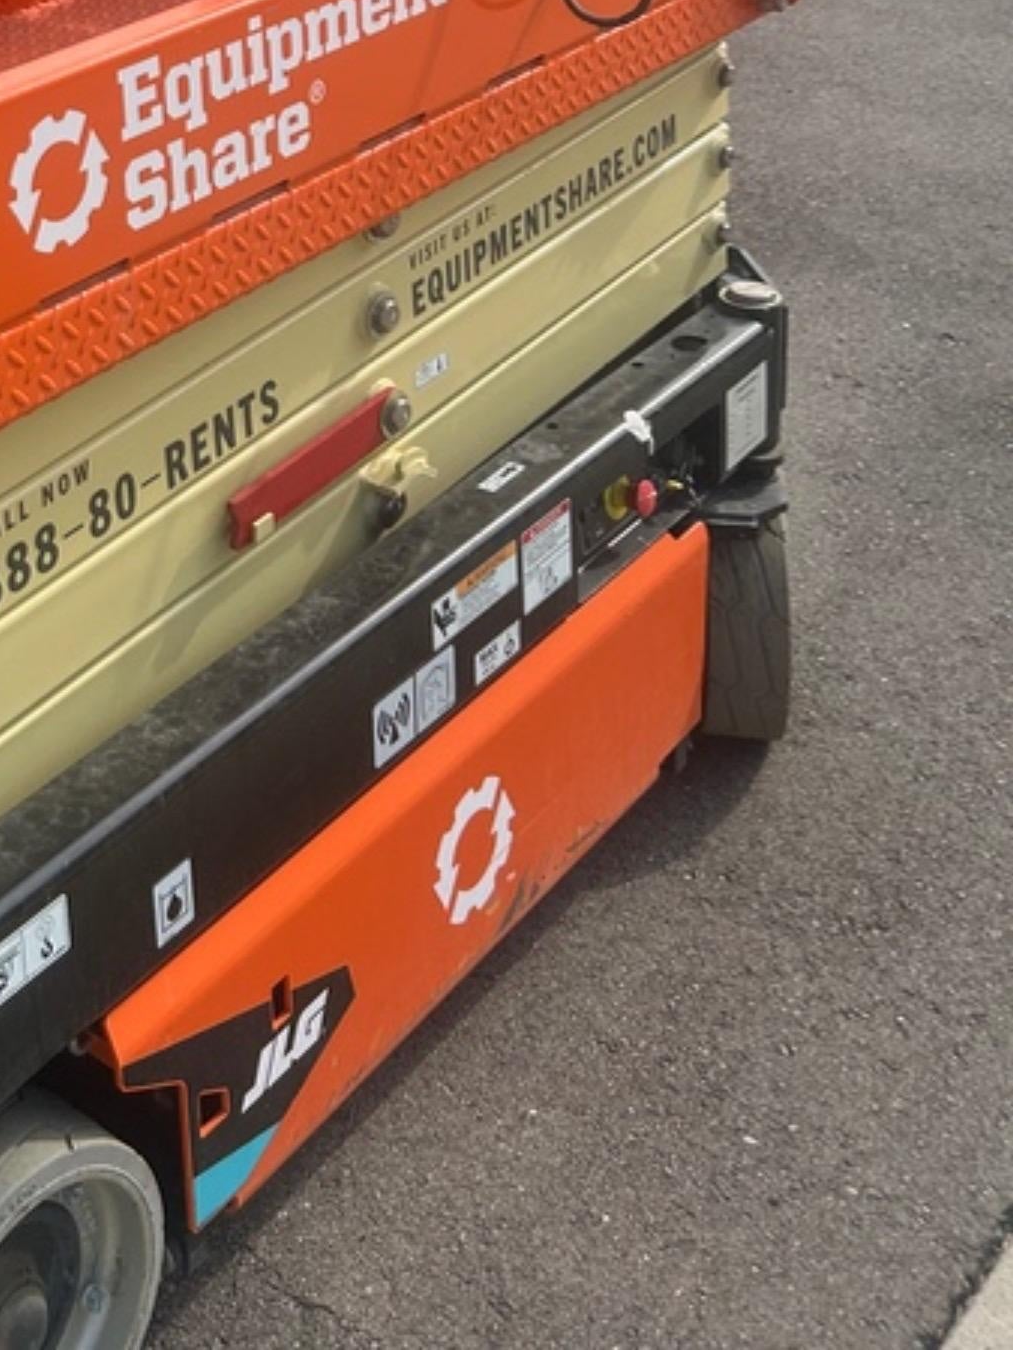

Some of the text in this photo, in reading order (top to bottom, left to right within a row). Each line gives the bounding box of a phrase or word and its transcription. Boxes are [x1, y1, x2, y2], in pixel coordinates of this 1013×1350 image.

[408, 233, 448, 270] VISIT
[412, 114, 676, 318] EQUIPMENTSHARE.COM
[41, 459, 91, 508] NOW
[241, 987, 329, 1113] JLG
